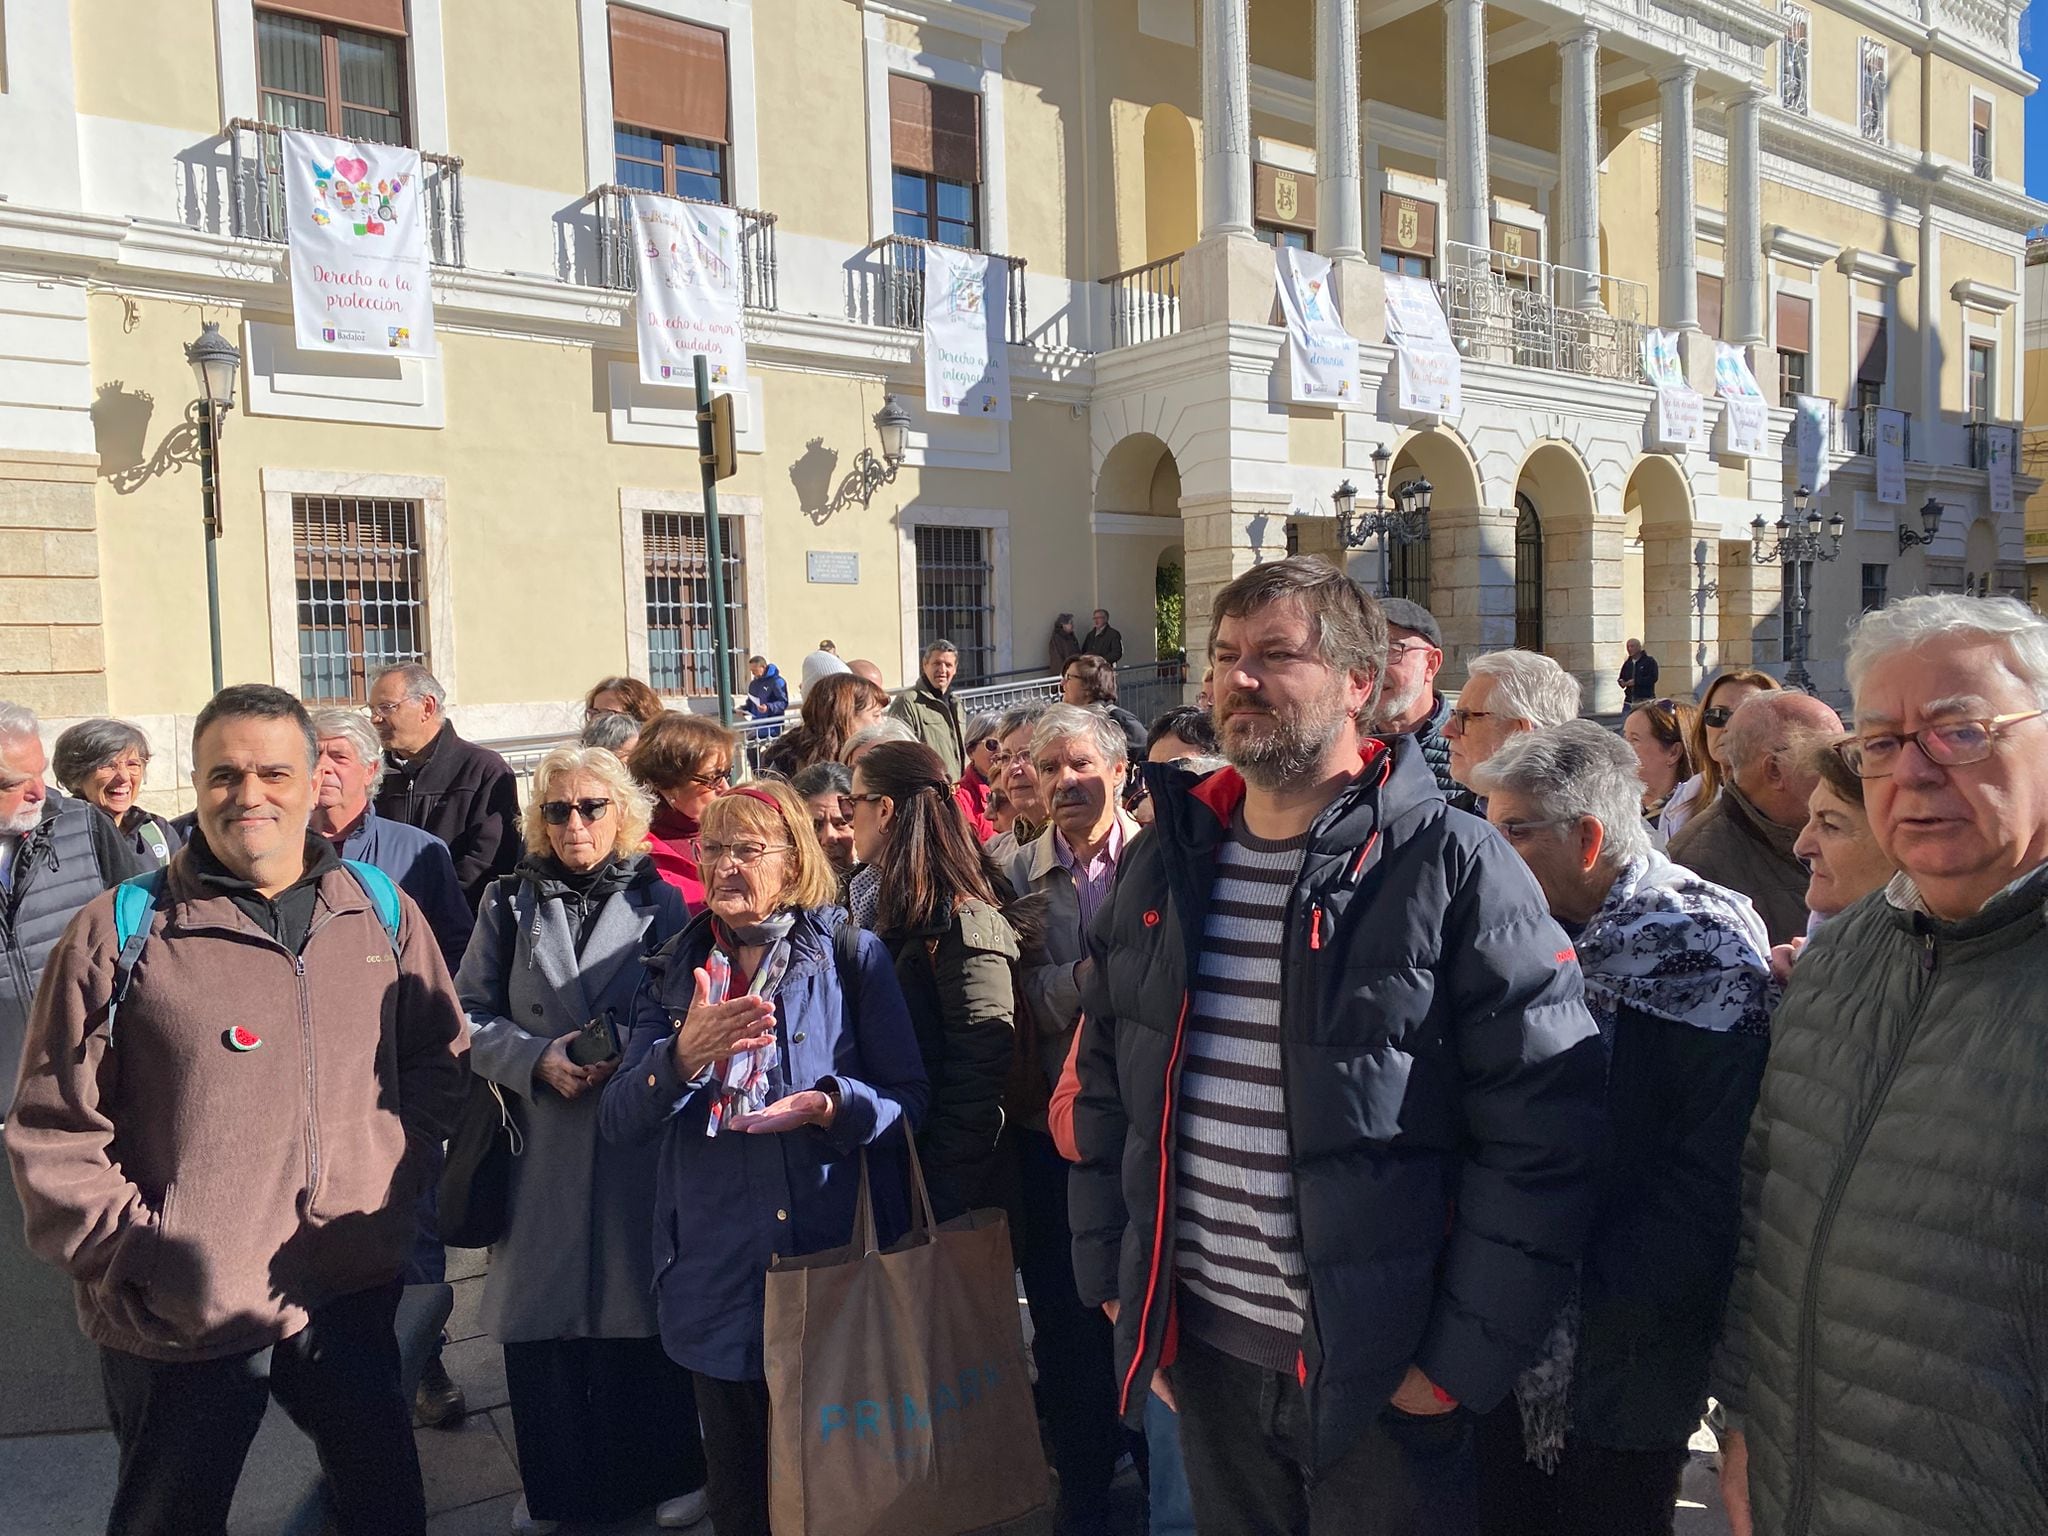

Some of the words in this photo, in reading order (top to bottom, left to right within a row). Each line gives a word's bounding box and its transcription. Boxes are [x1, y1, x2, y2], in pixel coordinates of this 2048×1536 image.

[313, 264, 372, 286] Derecho
[379, 277, 389, 289] a
[396, 274, 412, 291] la
[327, 292, 403, 312] protección
[1451, 267, 1550, 323] Felices
[337, 332, 366, 341] Badajoz
[709, 323, 735, 336] amor
[675, 337, 722, 353] cuidados
[938, 348, 975, 364] Derecho
[978, 358, 984, 367] a
[988, 355, 999, 368] la
[1556, 330, 1647, 382] Fiestas
